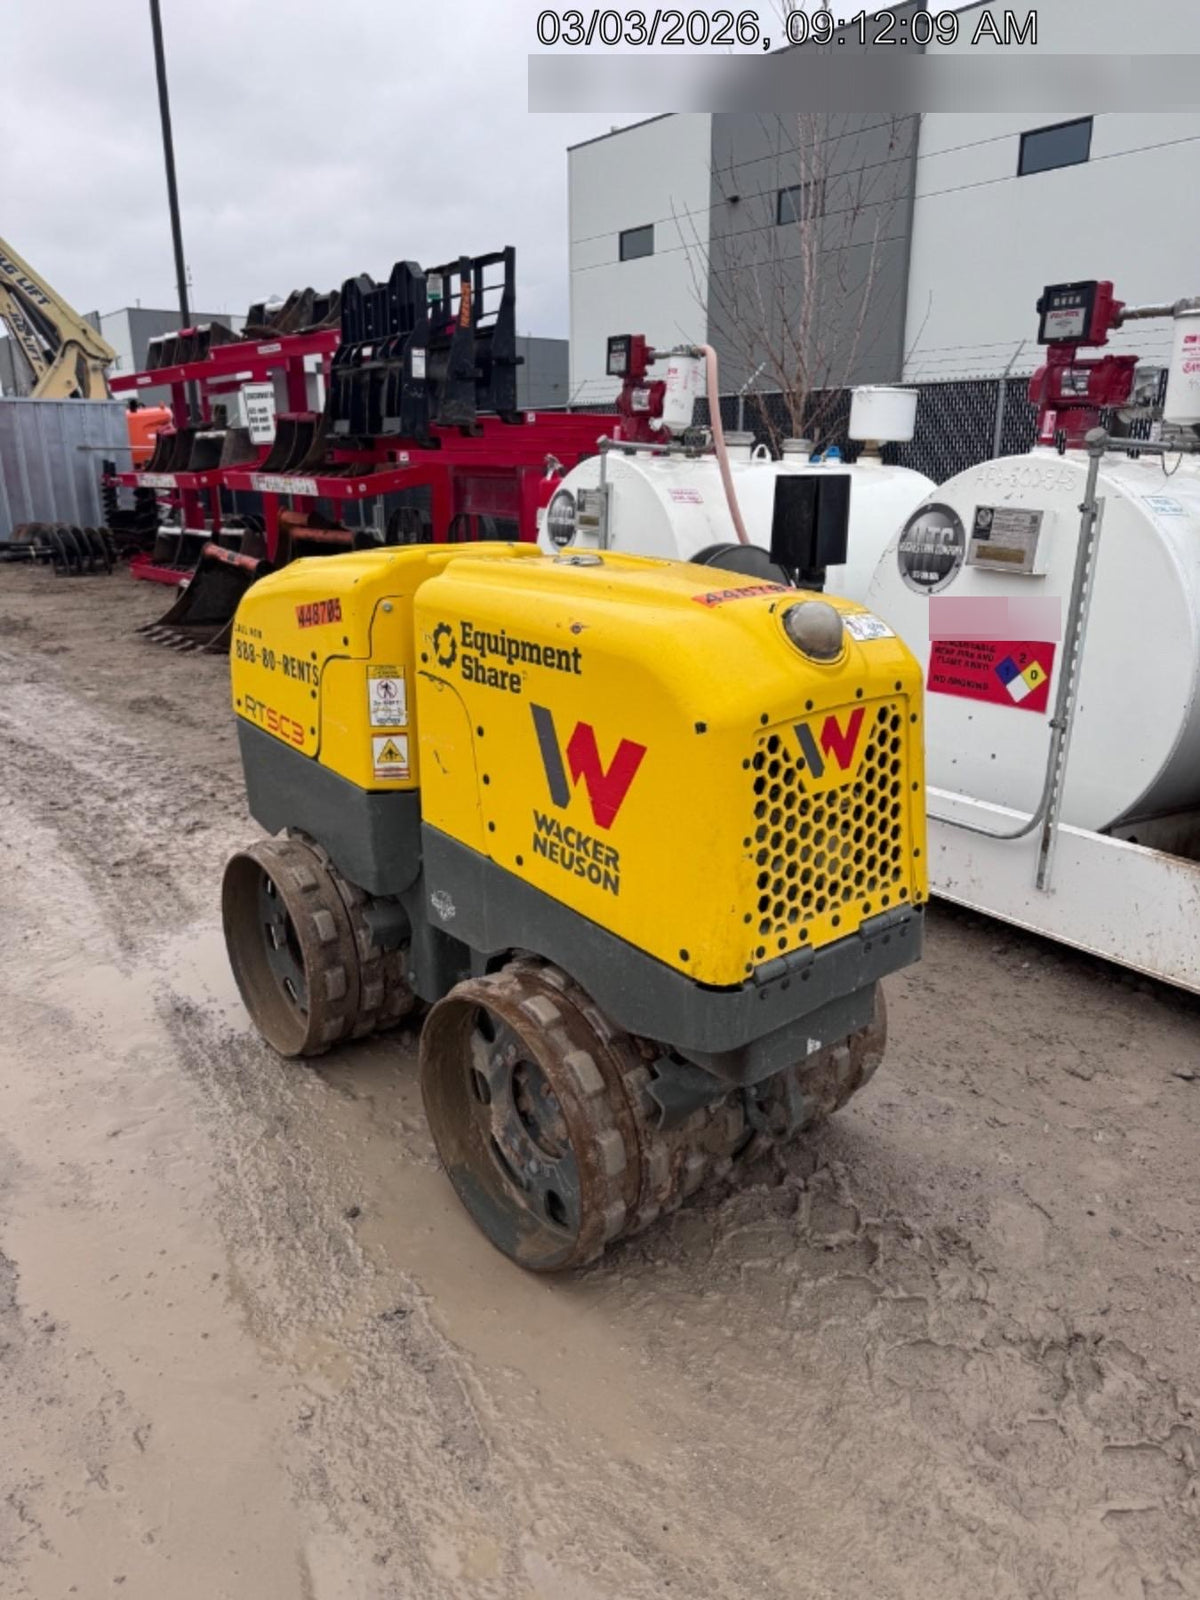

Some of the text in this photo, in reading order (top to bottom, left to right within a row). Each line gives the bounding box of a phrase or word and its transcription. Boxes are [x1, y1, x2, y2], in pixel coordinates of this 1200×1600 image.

[17, 277, 51, 305] LIFT
[235, 638, 319, 687] 888-80-RENTS
[460, 621, 582, 675] Equipment
[1020, 653, 1027, 664] 2
[461, 653, 522, 694] Share
[1030, 669, 1039, 681] 0
[533, 808, 620, 872] WACKER
[533, 832, 620, 896] NEUSON
